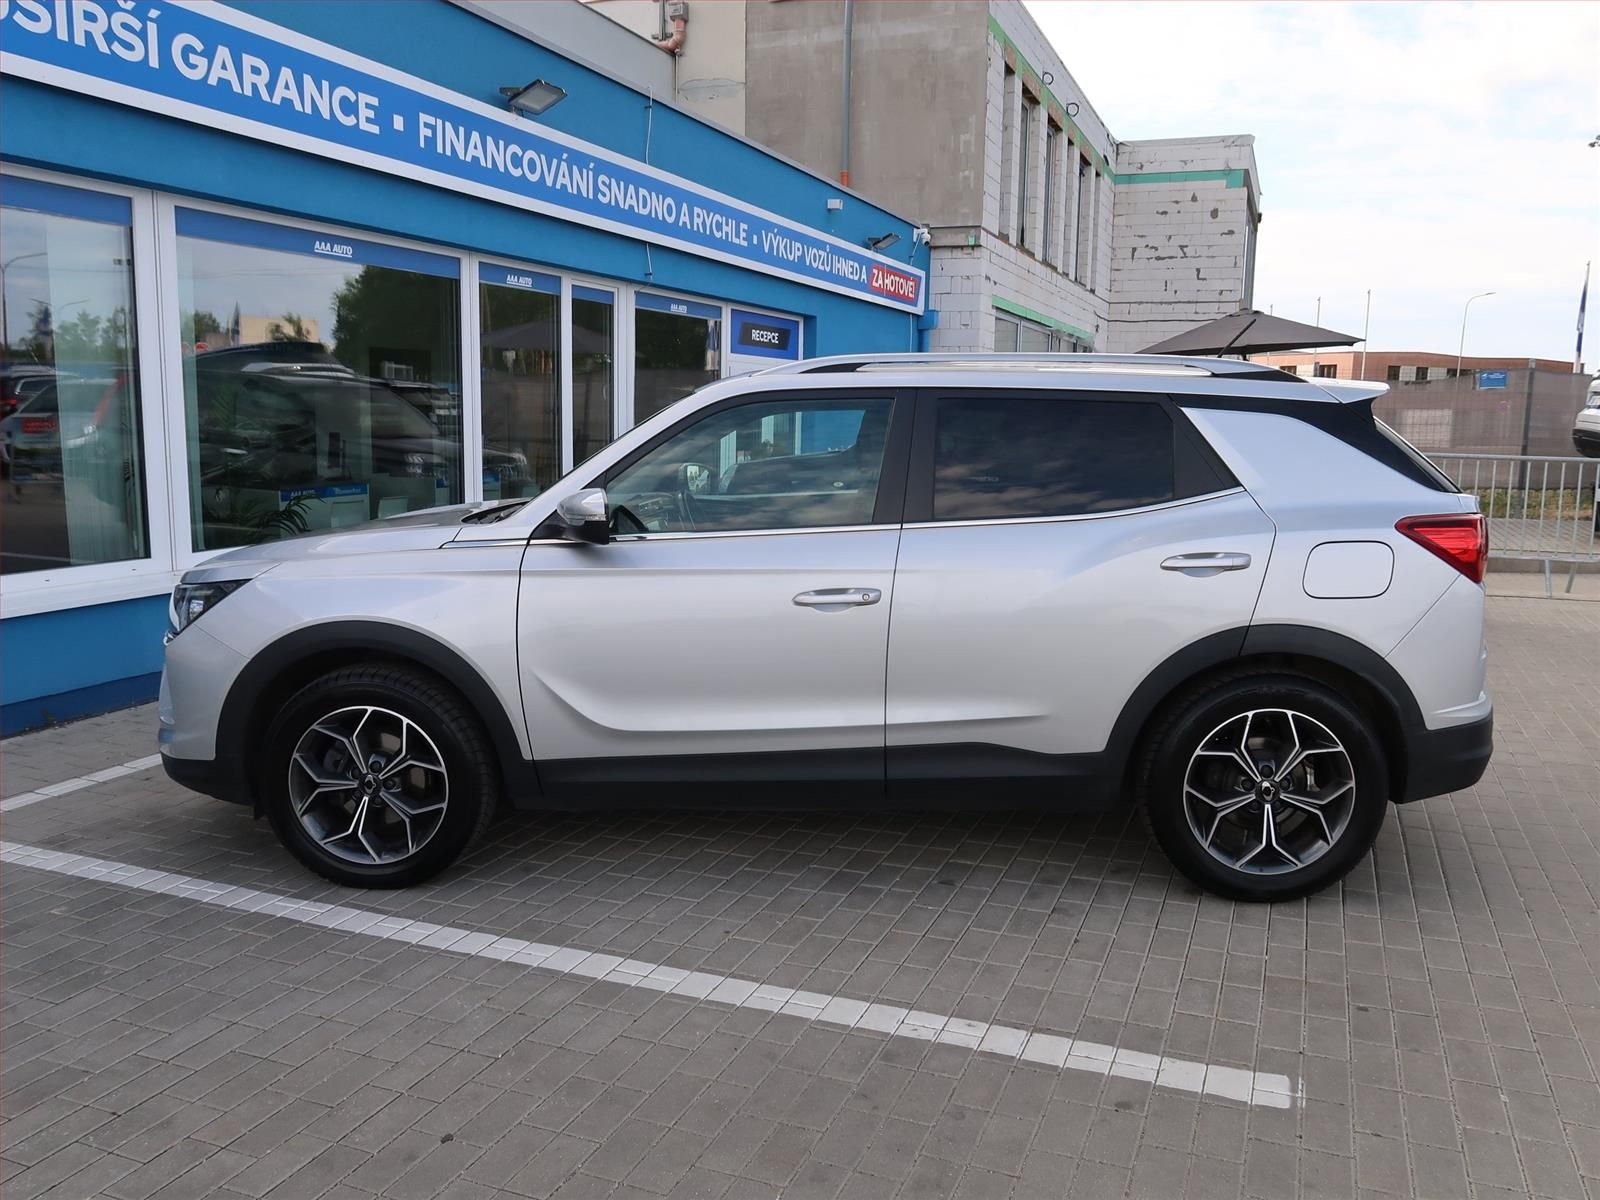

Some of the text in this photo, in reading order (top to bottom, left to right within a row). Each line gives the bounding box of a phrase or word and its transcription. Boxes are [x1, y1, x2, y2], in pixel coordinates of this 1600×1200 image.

[171, 33, 381, 135] GARANCE
[419, 112, 595, 200] FINANCOVÁNÍ
[597, 176, 676, 225] SNADNO
[679, 203, 691, 229] A
[693, 206, 749, 247] RYCHLE
[762, 229, 802, 263] VÝKUP
[805, 245, 831, 271] VOZŮ
[833, 257, 859, 280] IHNED
[861, 265, 867, 284] A
[873, 269, 883, 288] ZA
[314, 240, 352, 256] AAA AUTO
[519, 276, 533, 286] AUTO
[751, 329, 779, 344] RECEPCE
